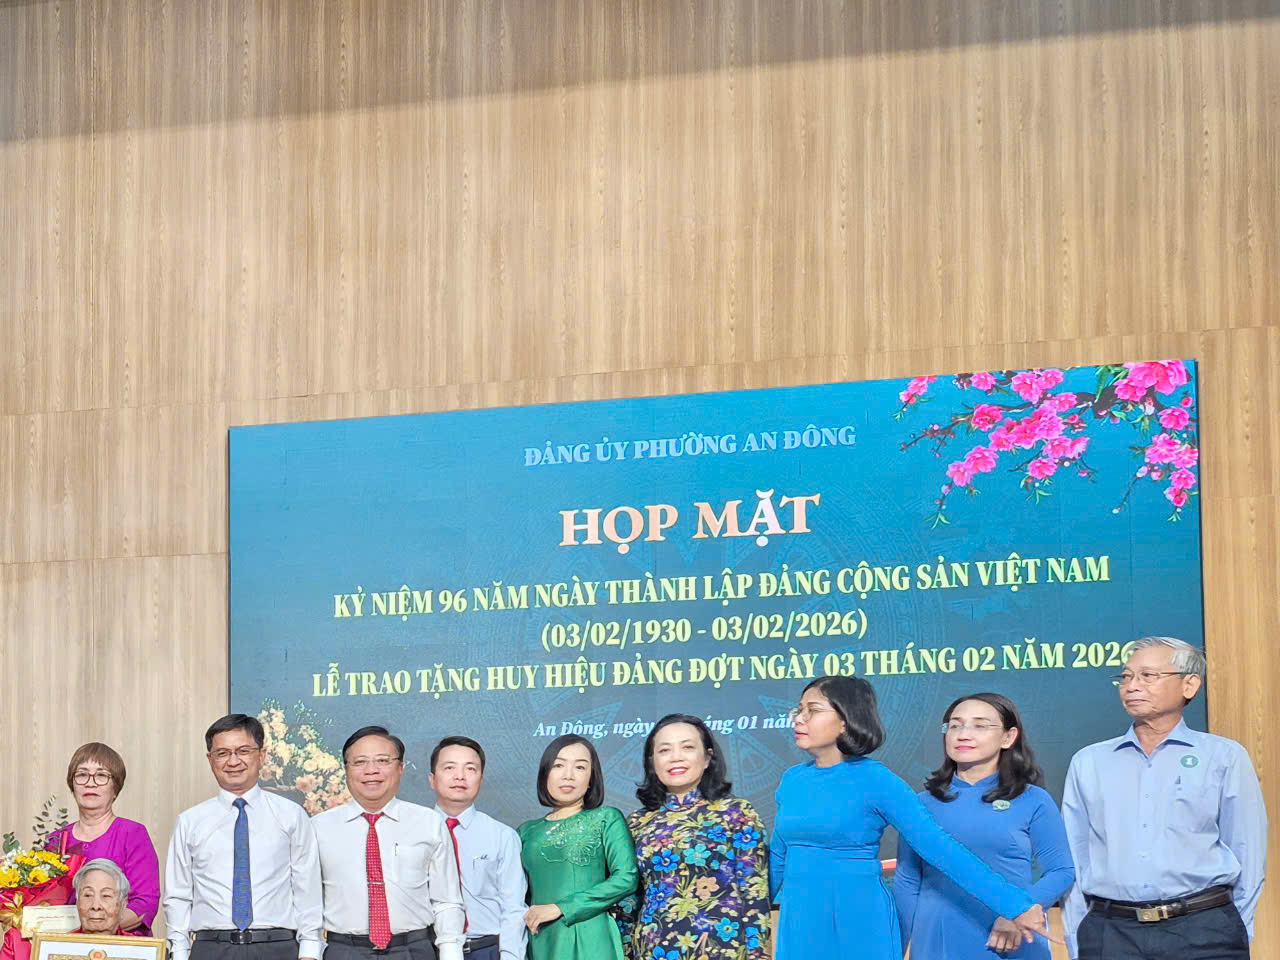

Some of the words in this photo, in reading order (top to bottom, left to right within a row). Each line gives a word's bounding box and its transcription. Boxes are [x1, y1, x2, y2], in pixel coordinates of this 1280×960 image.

[524, 441, 590, 467] ĐẢNG
[595, 436, 630, 462] ỦY
[633, 431, 737, 459] PHƯỜNG
[742, 431, 780, 452] AN
[783, 424, 857, 449] ĐÔNG
[558, 504, 679, 555] HỌP
[692, 488, 821, 547] MẶT
[333, 585, 366, 618] KỶ
[370, 583, 433, 622] NIỆM
[438, 589, 468, 613] 96
[473, 580, 529, 611] NĂM
[534, 575, 600, 608] NGÀY
[604, 571, 697, 605] THÀNH
[703, 567, 753, 607] LẬP
[758, 563, 831, 597] ĐẢNG
[836, 560, 910, 600] CỘNG
[916, 555, 970, 590] SẢN
[975, 551, 1041, 592] VIỆT
[1046, 555, 1111, 583] NAM
[541, 617, 692, 652] (03/02/1930
[711, 608, 868, 646] 03/02/2026)
[312, 662, 341, 697] LỄ
[344, 670, 412, 696] TRAO
[416, 662, 481, 700] TẶNG
[486, 664, 540, 690] HUY
[544, 655, 606, 694] HIỆU
[612, 652, 684, 686] ĐẢNG
[688, 652, 744, 689] ĐỢT
[749, 647, 819, 681] NGÀY
[823, 652, 855, 677] 03
[860, 641, 957, 676] THÁNG
[962, 646, 996, 672] 02
[1001, 637, 1065, 671] NĂM
[533, 722, 557, 736] An
[560, 719, 609, 739] Đông,
[613, 717, 655, 738] ngày
[737, 715, 758, 730] 01
